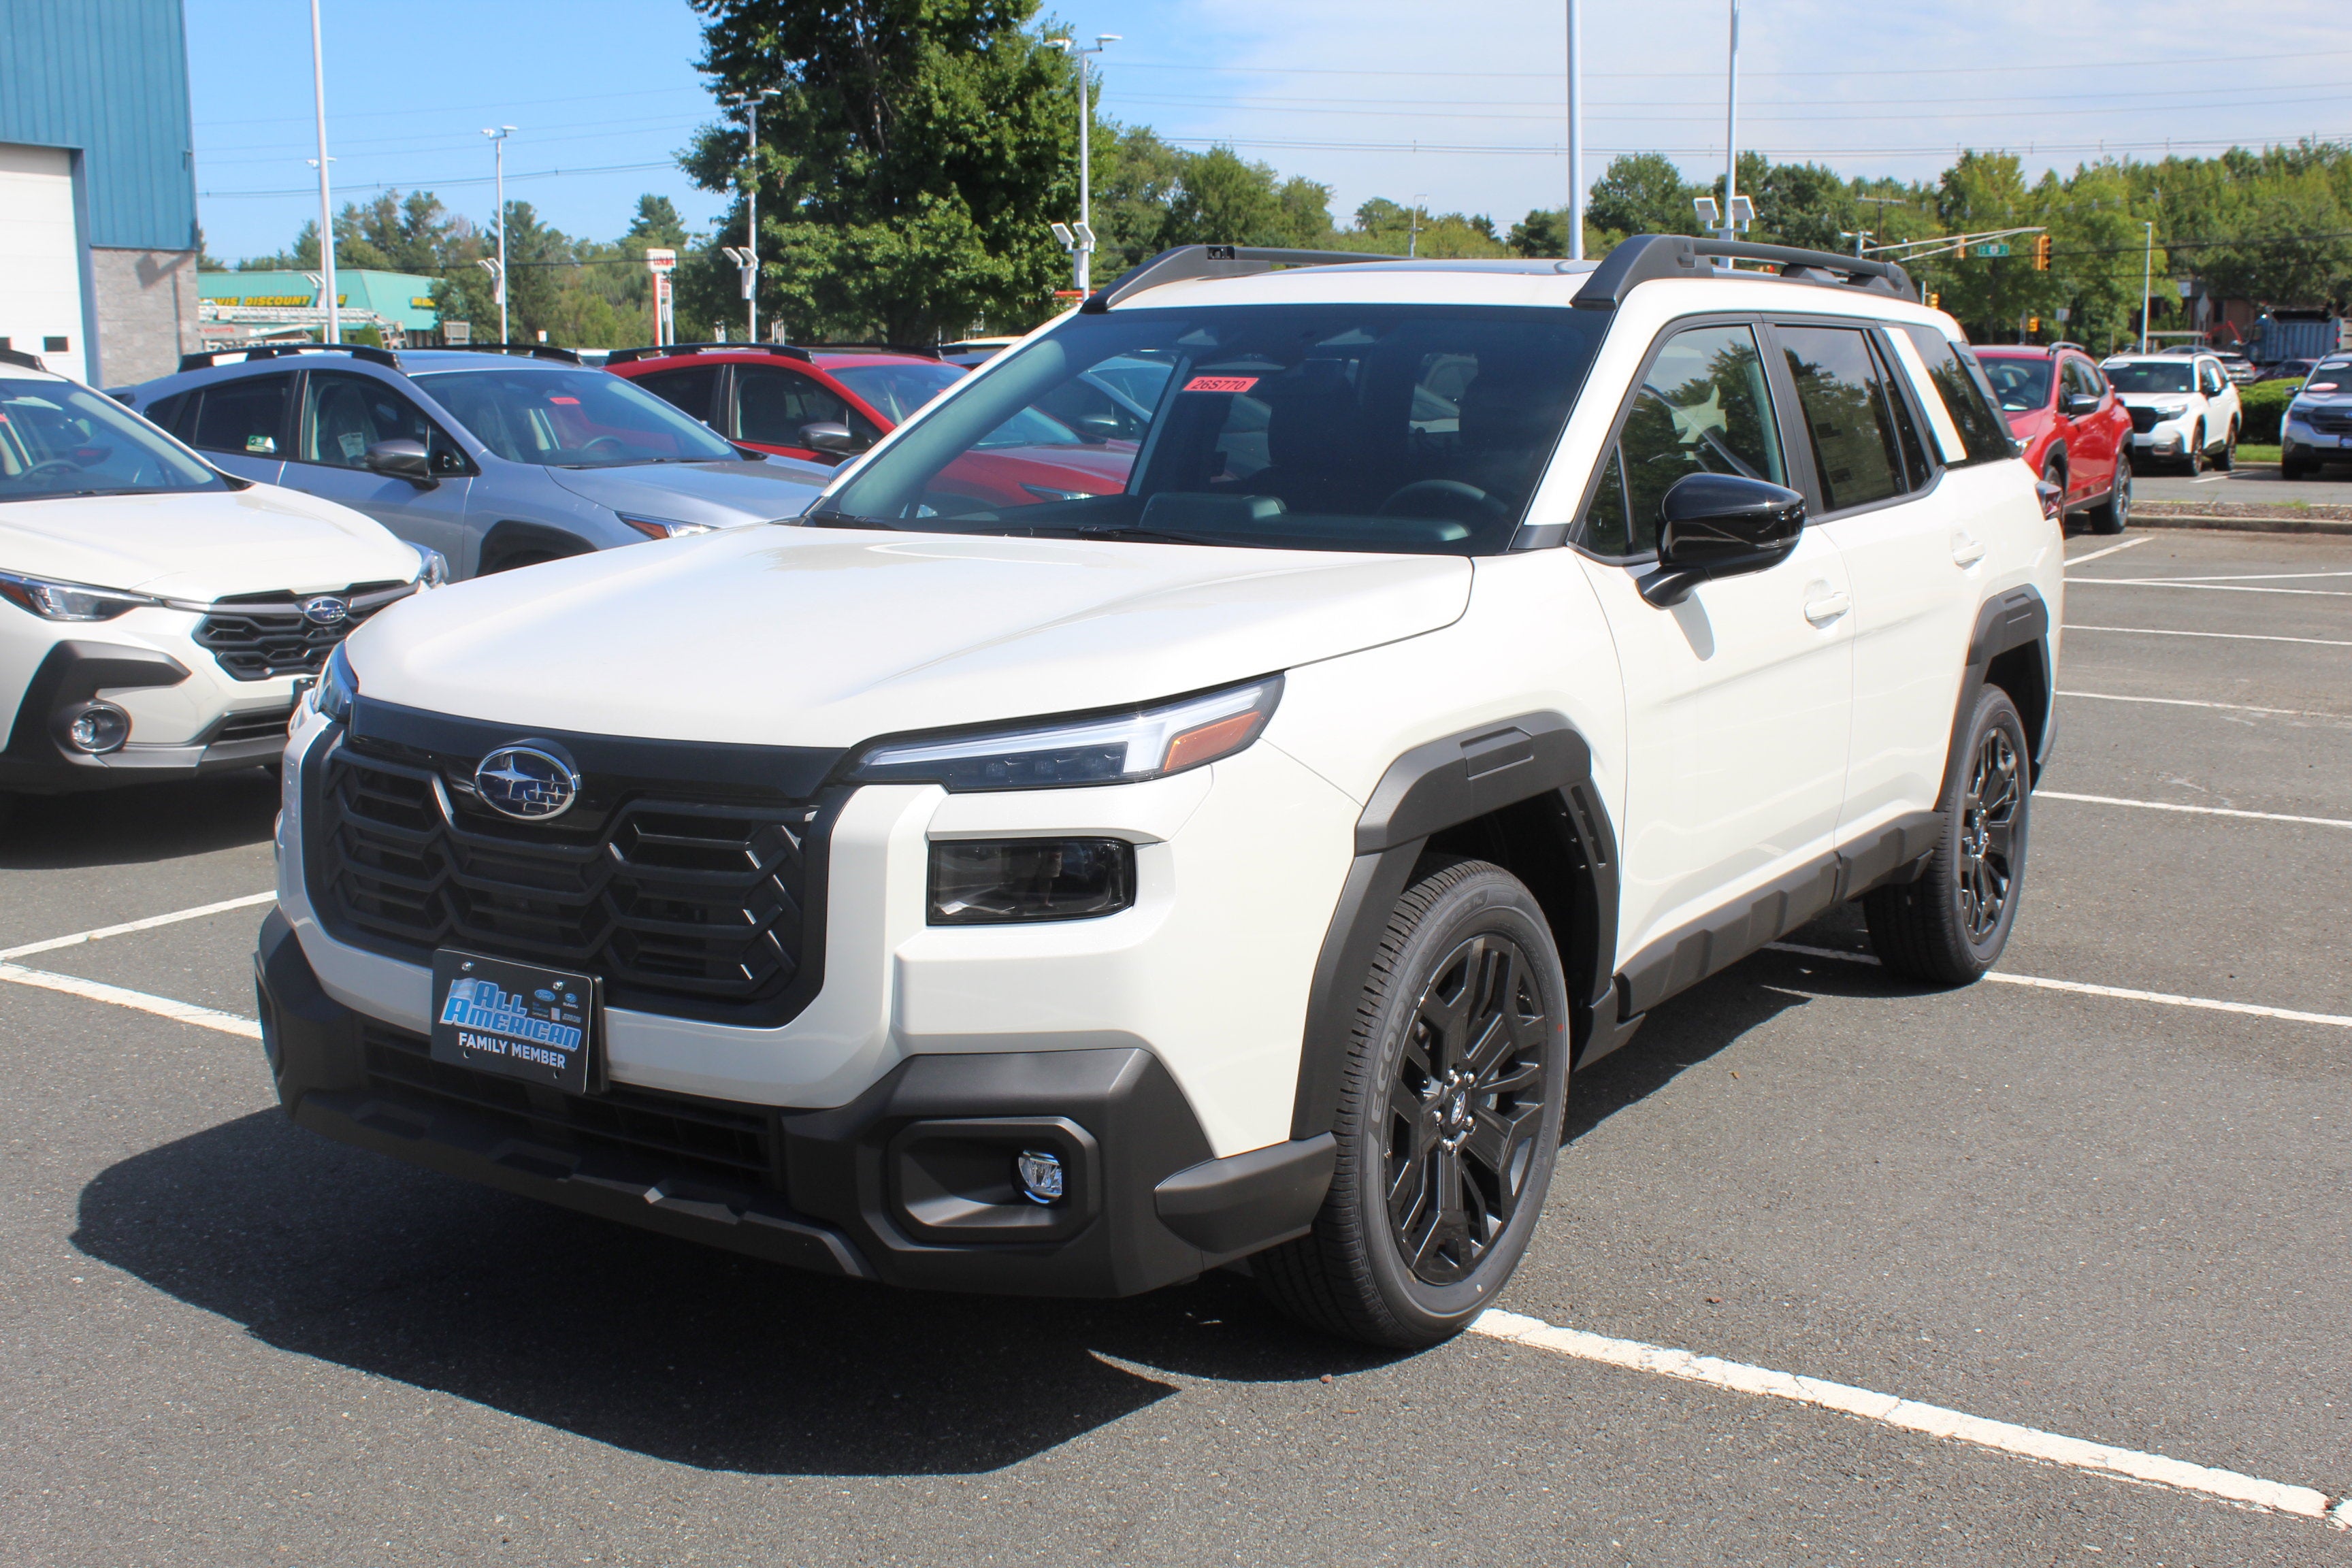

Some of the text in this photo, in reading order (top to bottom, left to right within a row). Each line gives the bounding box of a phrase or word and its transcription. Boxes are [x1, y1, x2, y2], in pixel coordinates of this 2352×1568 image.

[244, 295, 310, 306] DISCOUNT
[1191, 380, 1247, 390] 26S770
[473, 980, 527, 1016] ALL
[442, 996, 581, 1051] AMERICAN
[459, 1032, 566, 1069] FAMILY MEMBER
